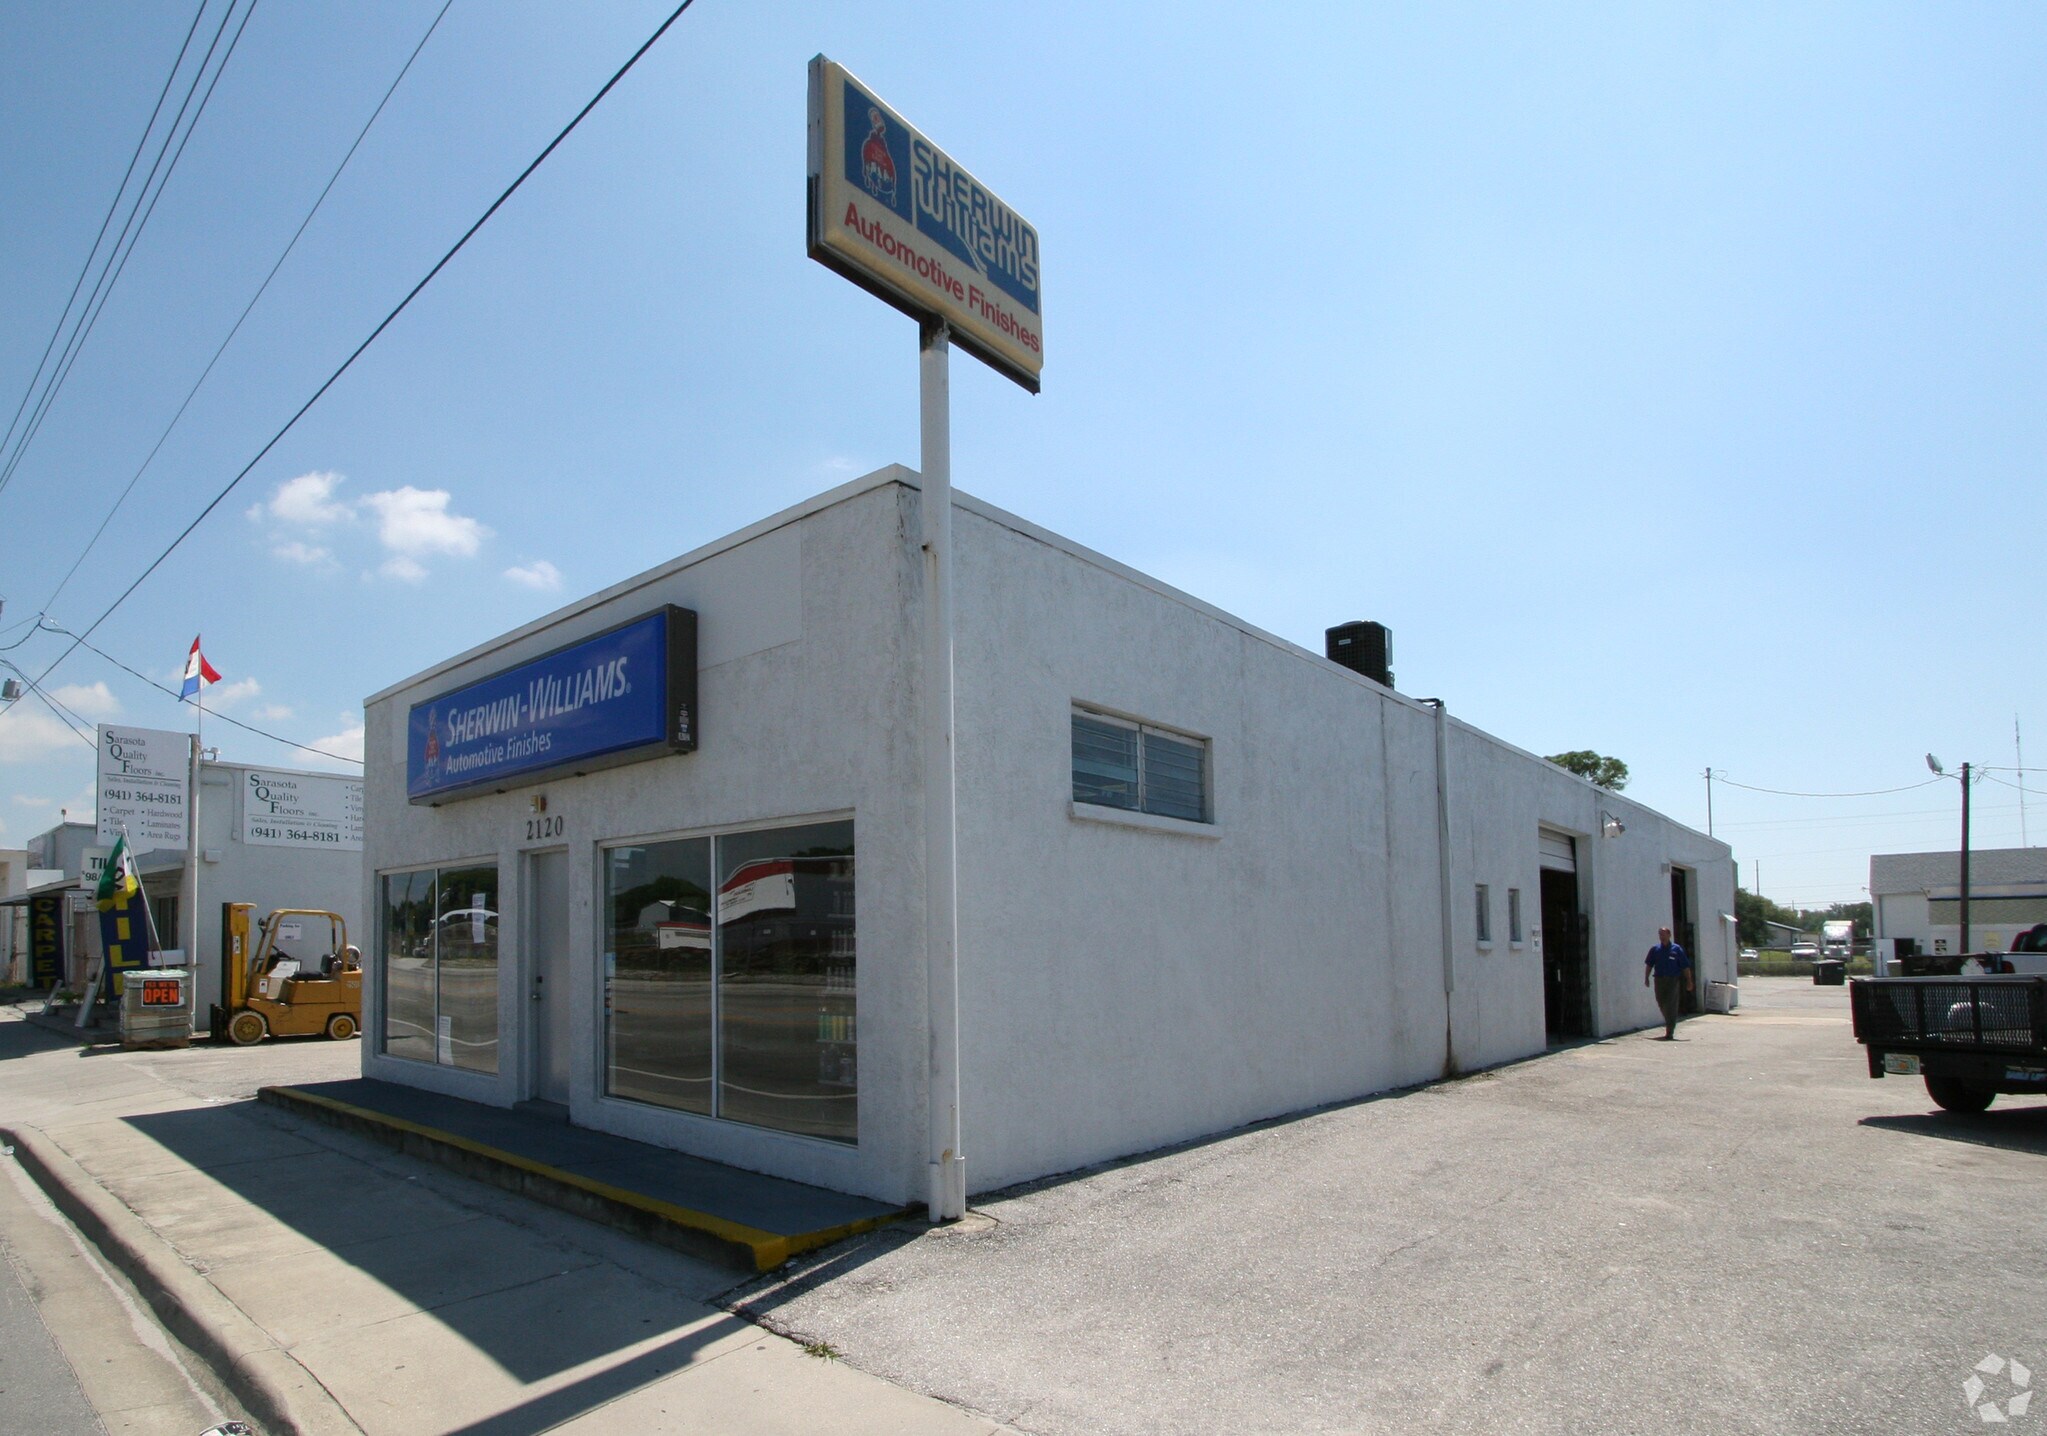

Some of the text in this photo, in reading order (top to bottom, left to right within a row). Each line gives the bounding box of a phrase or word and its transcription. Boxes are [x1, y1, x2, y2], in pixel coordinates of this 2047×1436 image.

[913, 139, 1037, 264] SHERWIN
[844, 202, 1040, 352] Automotive Finishes
[105, 731, 146, 746] Sarasota
[110, 744, 148, 762] Quality
[446, 742, 504, 775] Automotive
[506, 731, 552, 759] Finishes
[123, 760, 152, 775] Floors
[250, 774, 298, 789] Sarasota
[105, 789, 182, 804] (941) 364-8181
[255, 786, 299, 804] Quality
[109, 806, 135, 817] Carpet
[147, 809, 183, 819] Hardwood
[270, 801, 305, 816] Floors
[109, 817, 124, 825] Tile
[147, 820, 181, 829] Laminates
[526, 815, 563, 840] 2120
[147, 831, 181, 842] Area Rugs
[251, 827, 340, 842] (941) 364-8181
[35, 898, 57, 991] CARPET
[144, 988, 179, 1003] OPEN
